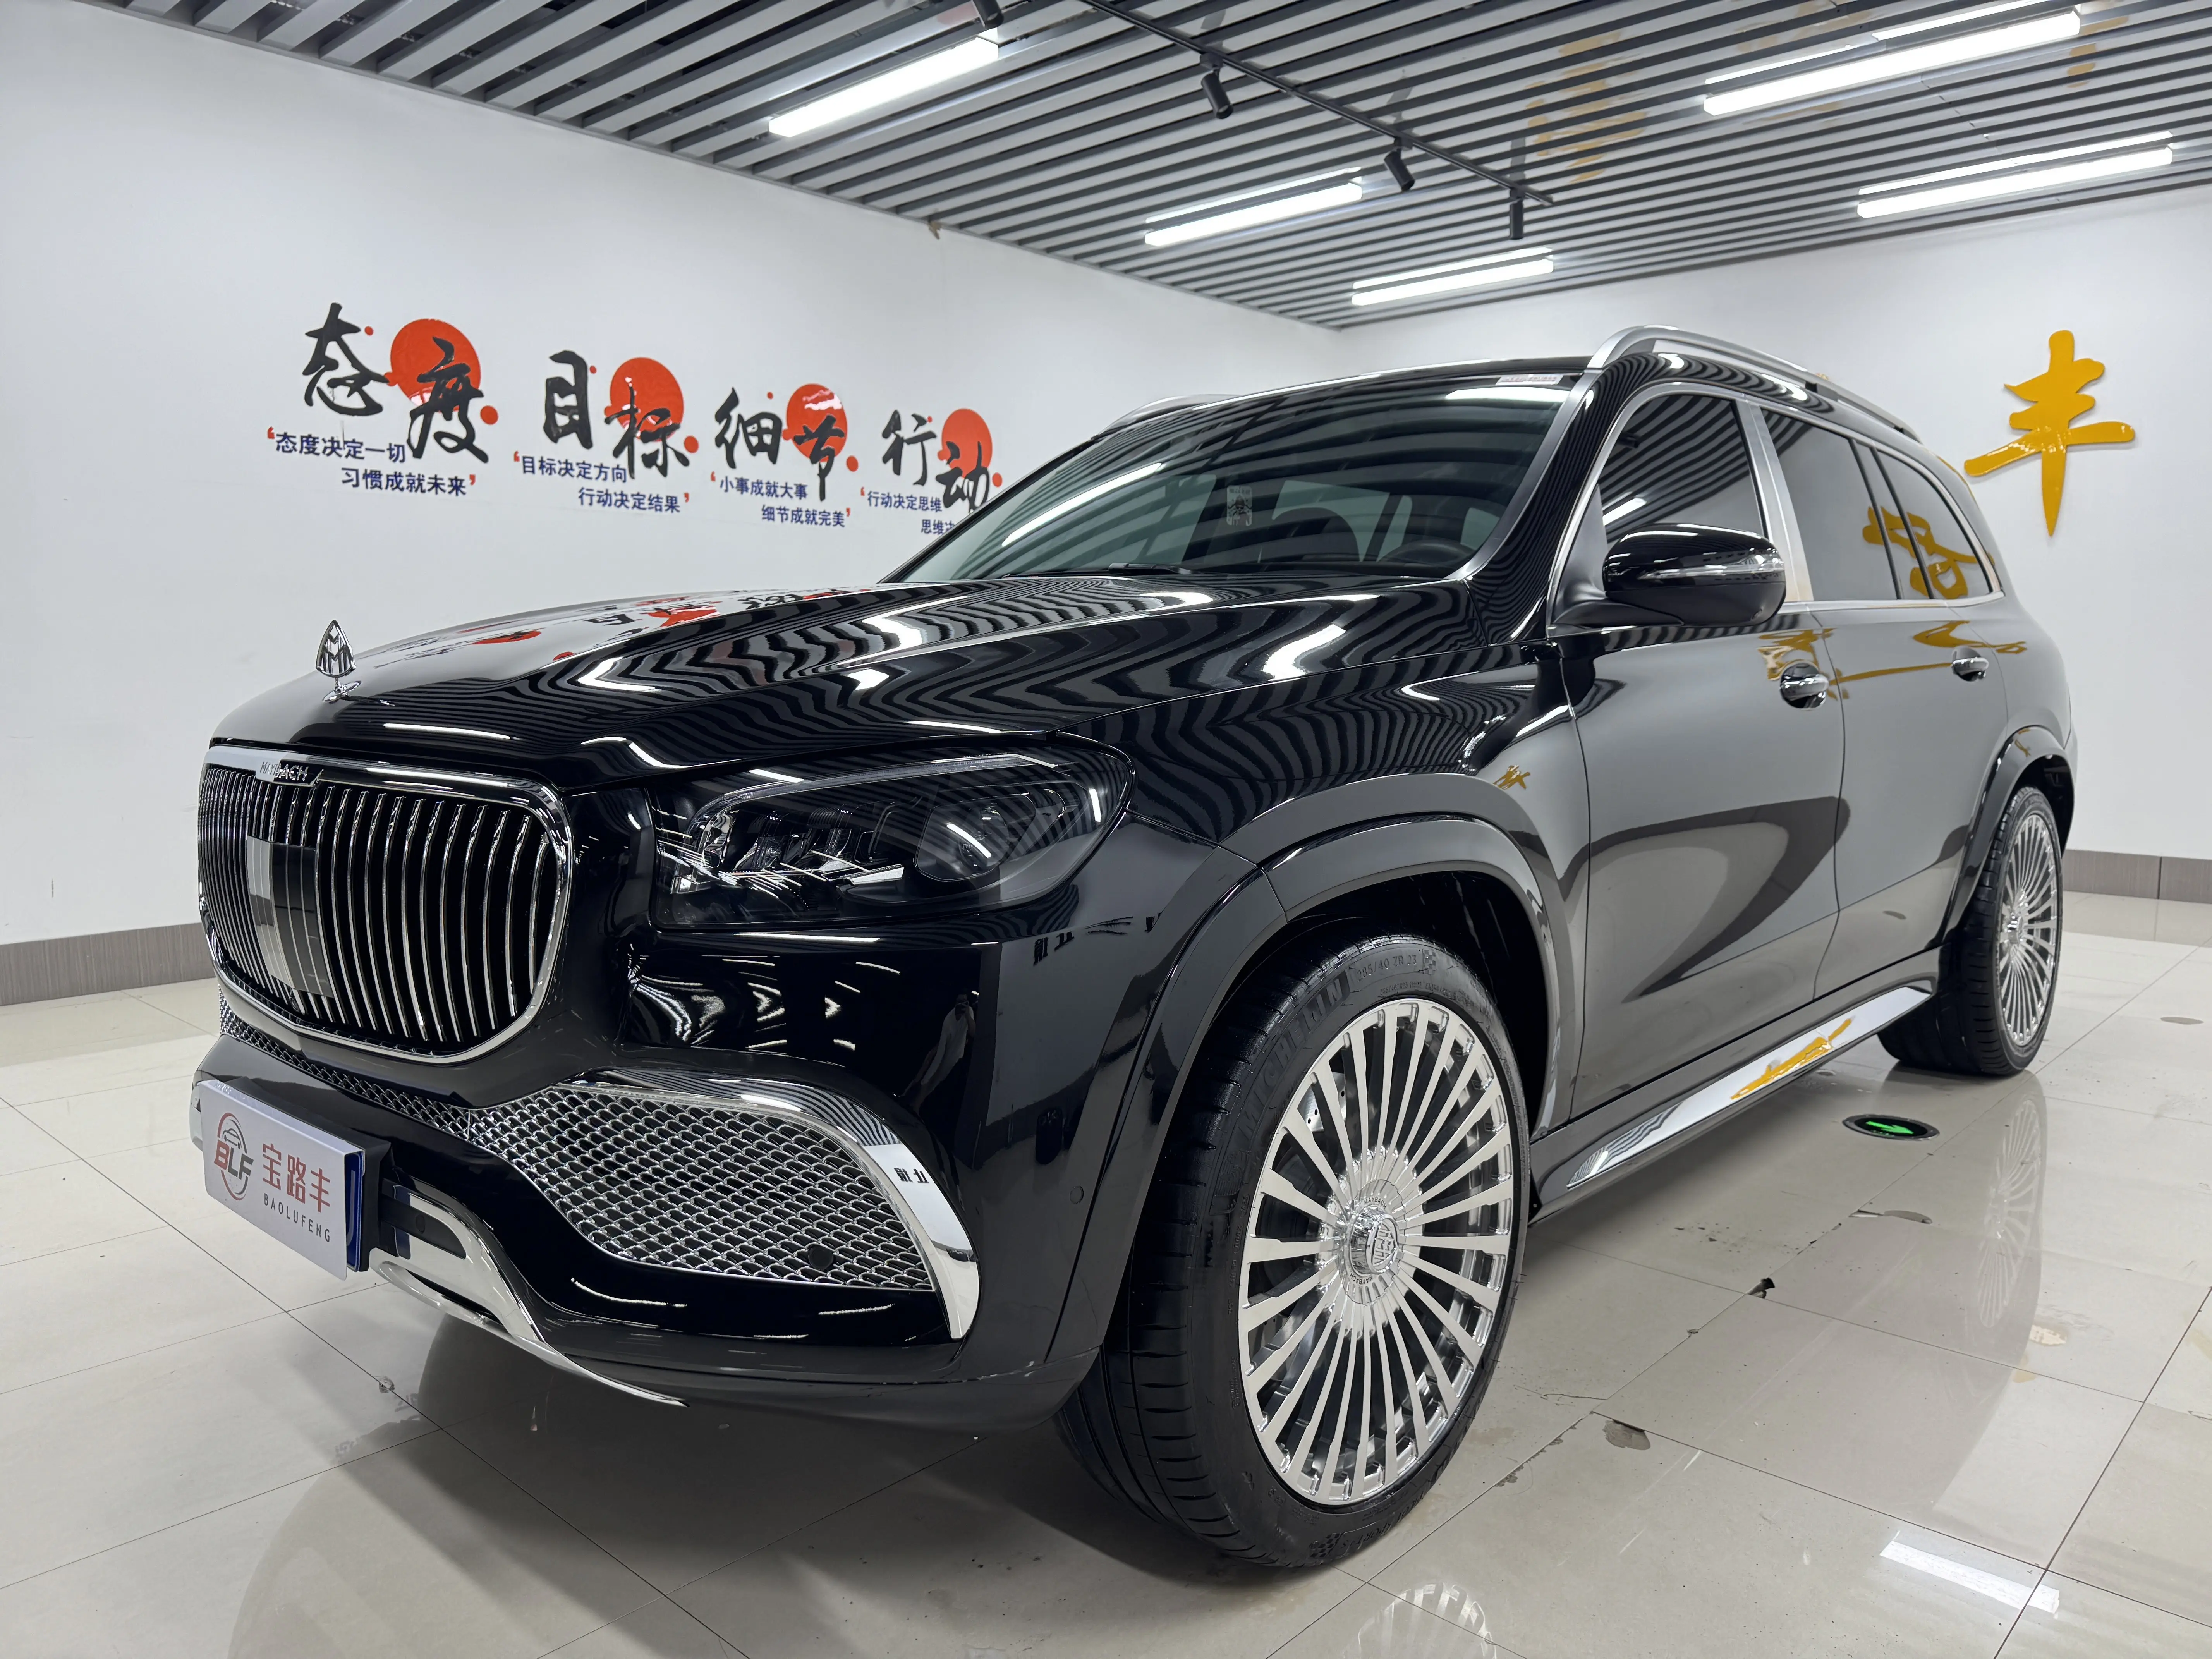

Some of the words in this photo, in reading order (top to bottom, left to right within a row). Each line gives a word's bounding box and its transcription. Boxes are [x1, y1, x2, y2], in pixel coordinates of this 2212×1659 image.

[262, 1143, 330, 1213] 宝路丰
[1364, 1196, 1387, 1209] MAYBACH
[264, 1193, 330, 1242] BAOLUFENG
